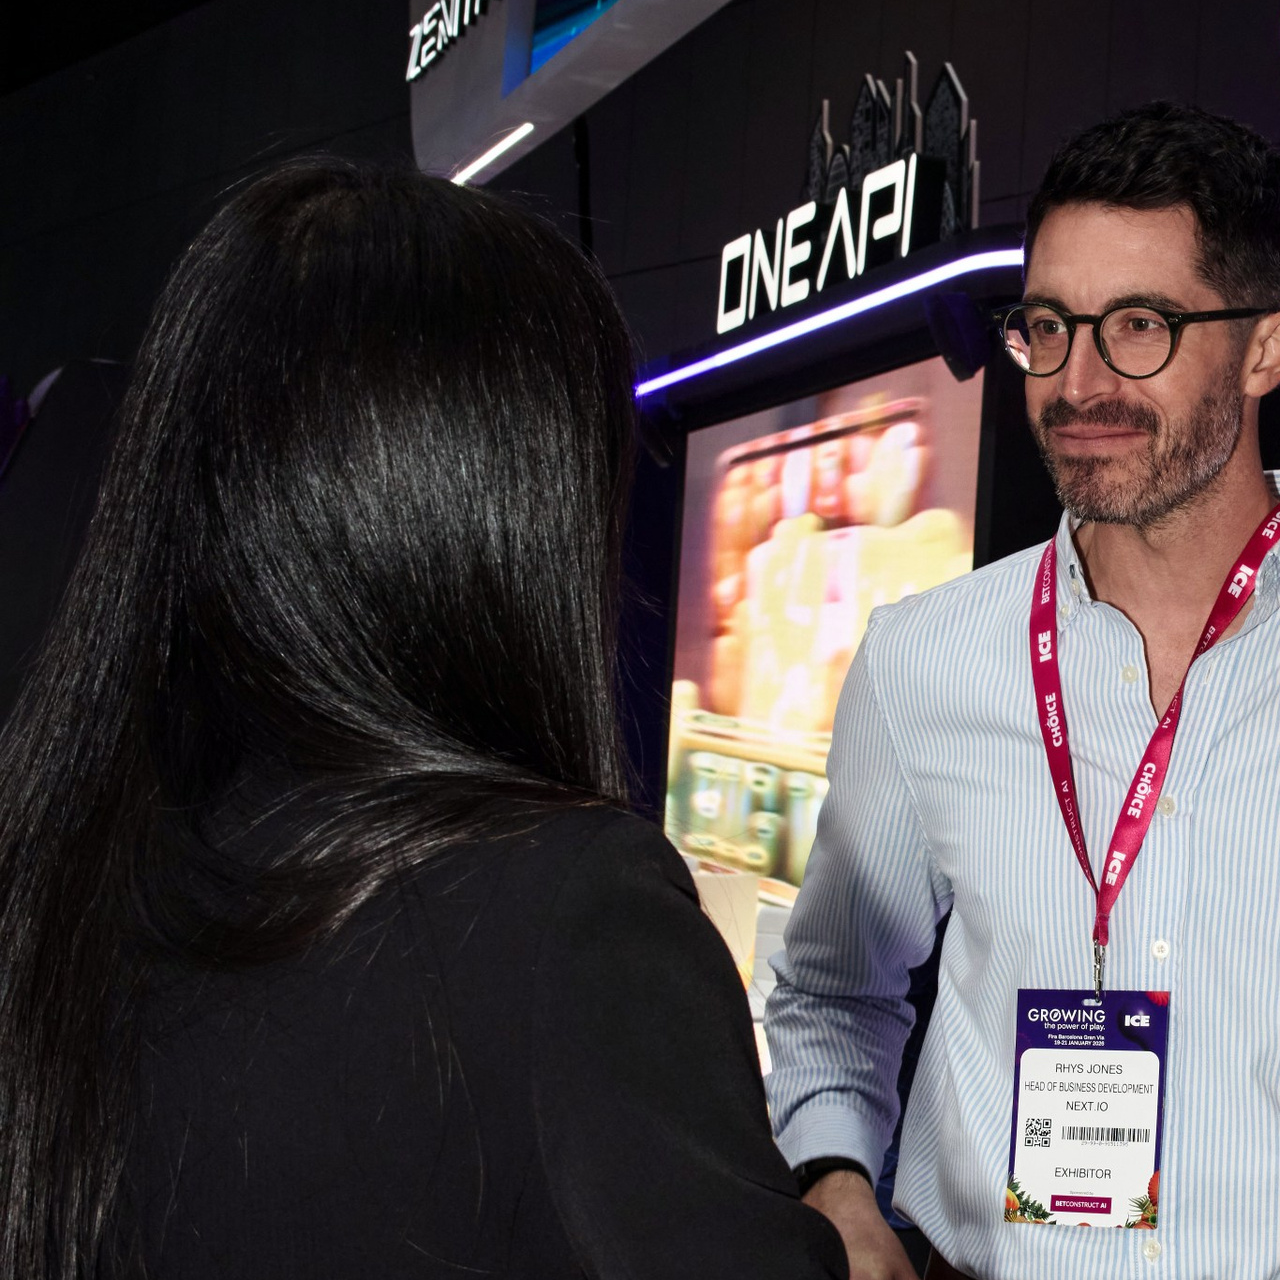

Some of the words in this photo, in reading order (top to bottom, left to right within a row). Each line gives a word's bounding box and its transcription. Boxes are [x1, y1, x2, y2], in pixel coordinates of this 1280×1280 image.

[1228, 564, 1255, 599] ICE
[1038, 631, 1052, 663] ICE
[1045, 692, 1063, 747] CHOICE
[1162, 716, 1171, 728] AI
[1061, 780, 1069, 793] AI
[1127, 762, 1157, 819] CHOICE
[1105, 850, 1127, 886] ICE
[1028, 1008, 1106, 1023] GROWING
[1124, 1015, 1150, 1027] ICE
[1057, 1023, 1079, 1031] power
[1089, 1023, 1105, 1031] play.
[1055, 1063, 1084, 1073] RHYS
[1087, 1064, 1123, 1075] JONES
[1024, 1081, 1045, 1092] HEAD
[1047, 1081, 1057, 1092] OF
[1059, 1081, 1096, 1093] BUSINESS
[1098, 1083, 1154, 1094] DEVELOPMENT
[1065, 1101, 1109, 1112] NEXT.IO
[1055, 1167, 1111, 1179] EXHIBITOR
[1055, 1200, 1099, 1209] BETCONSTRUCT
